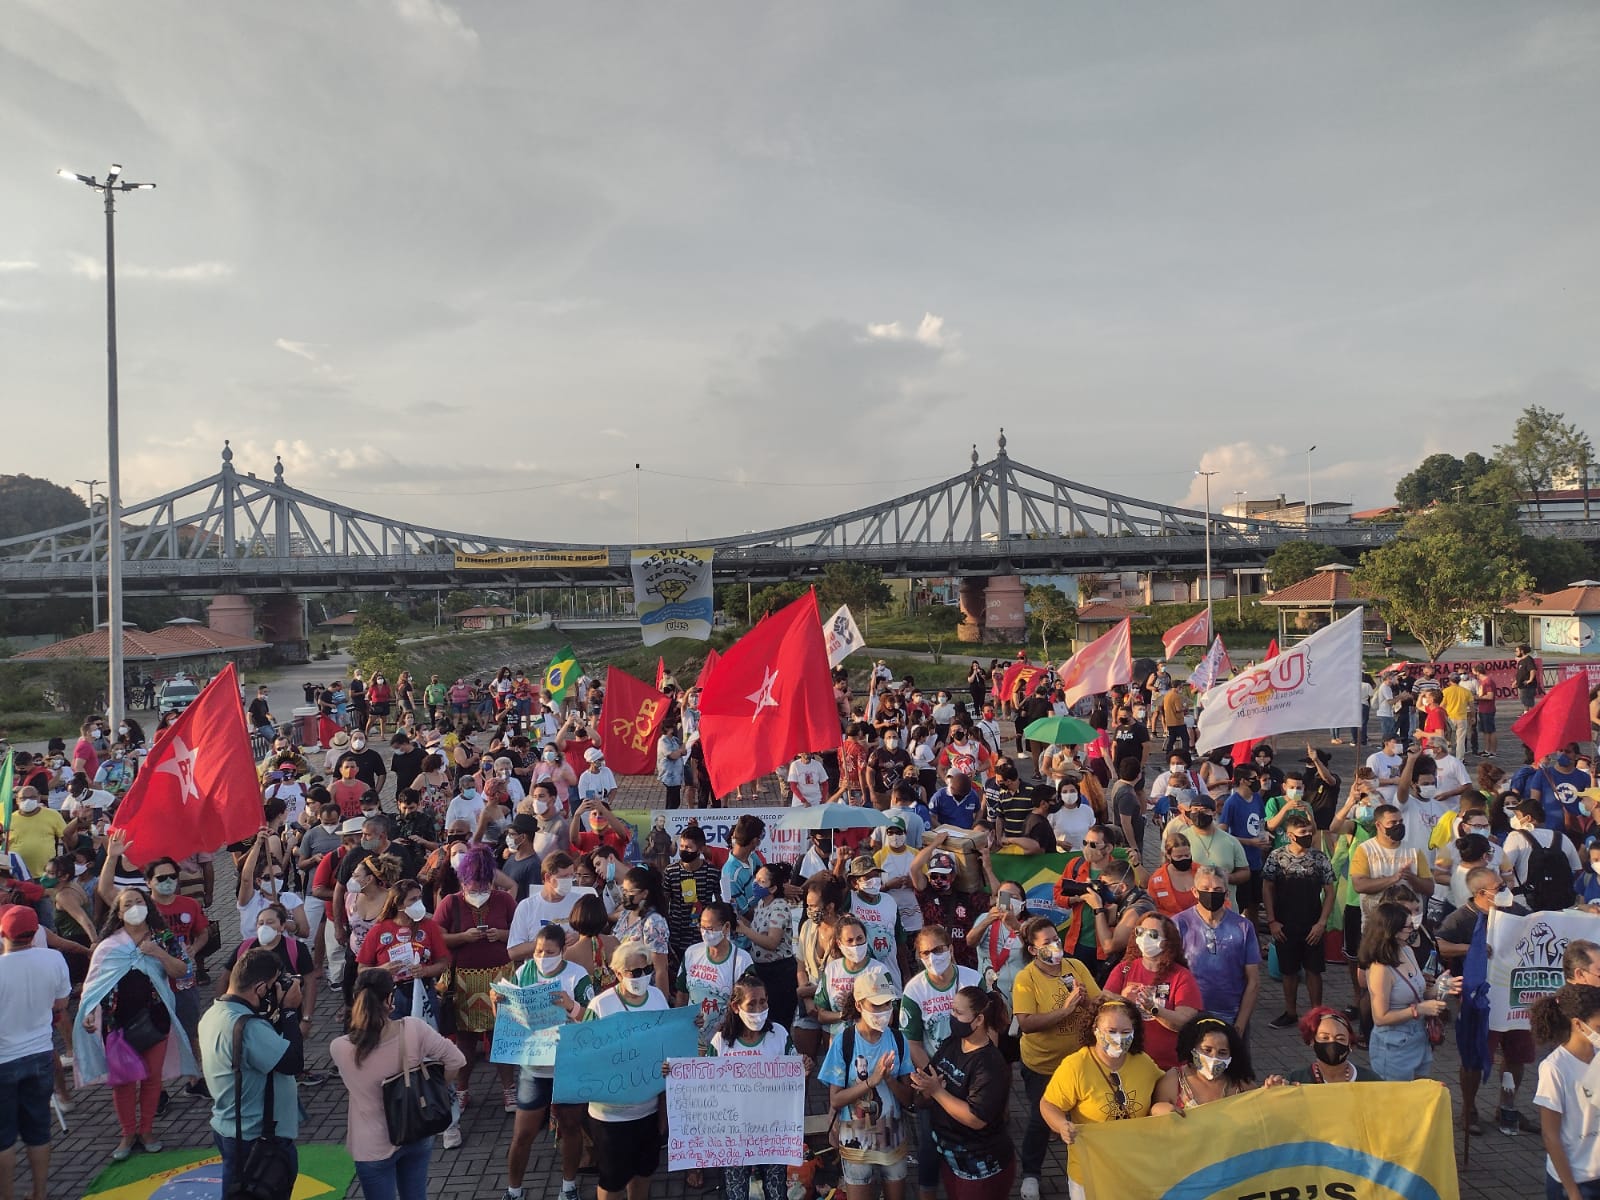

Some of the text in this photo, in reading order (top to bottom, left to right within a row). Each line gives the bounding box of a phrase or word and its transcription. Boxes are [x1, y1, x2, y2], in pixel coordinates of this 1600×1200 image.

[641, 548, 704, 570] REVOLTA
[654, 557, 690, 570] PELA
[646, 567, 698, 583] VACINA
[631, 698, 659, 755] PCB
[178, 758, 192, 785] PT
[1513, 971, 1564, 989] ASPRO
